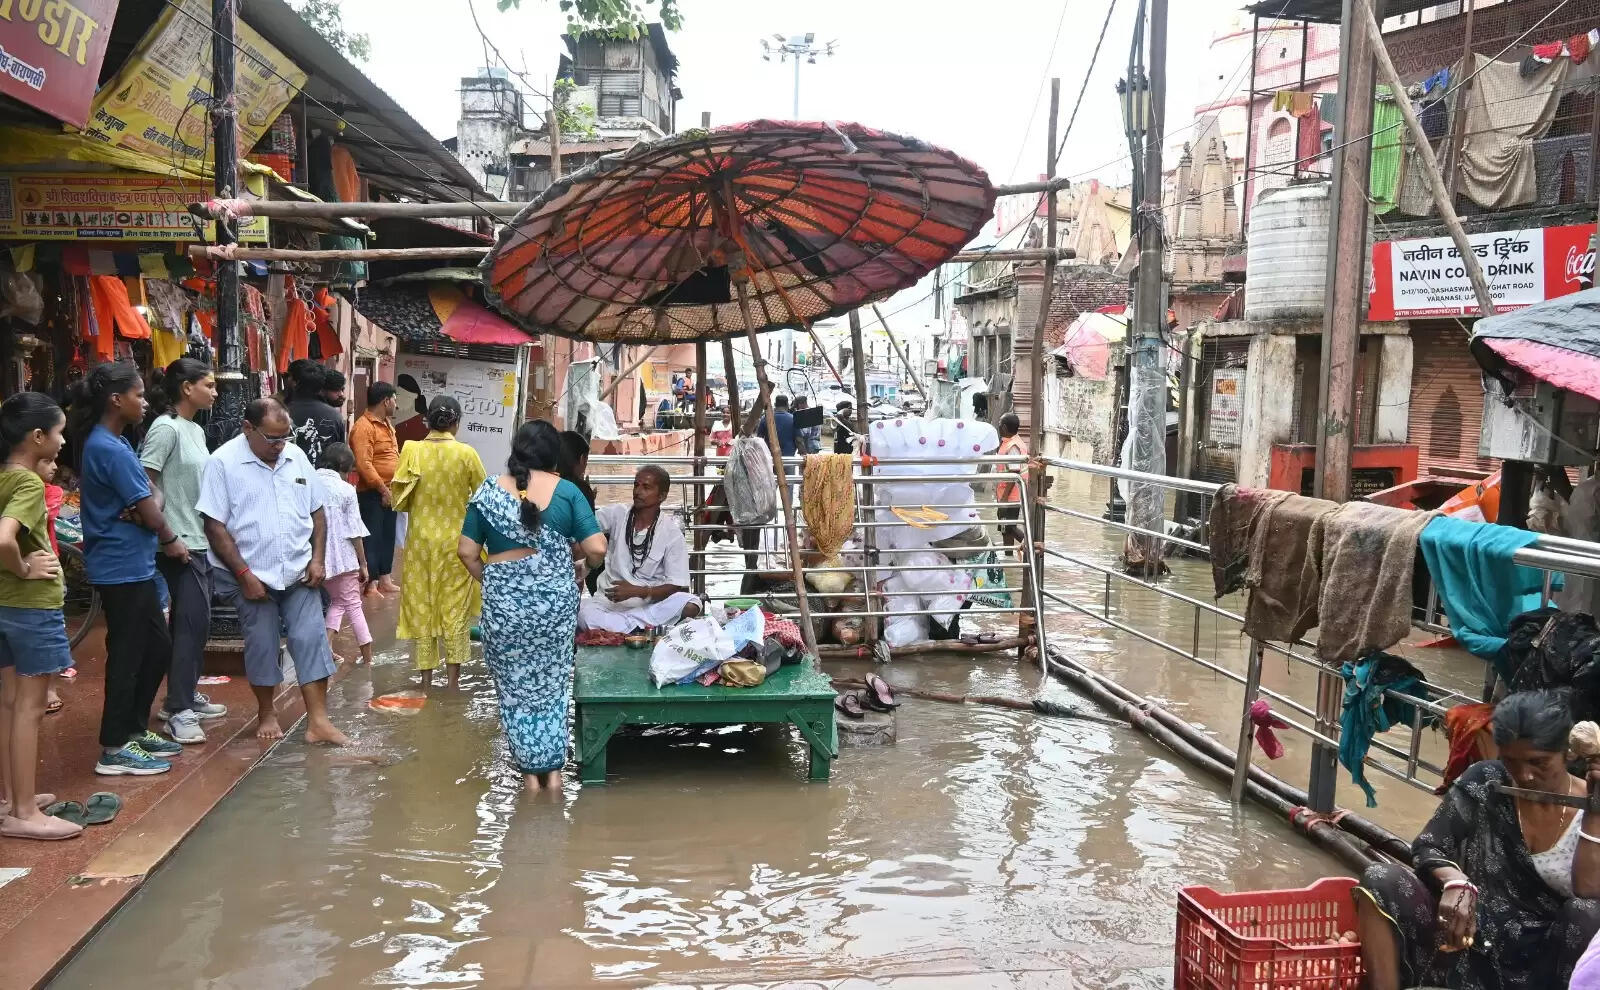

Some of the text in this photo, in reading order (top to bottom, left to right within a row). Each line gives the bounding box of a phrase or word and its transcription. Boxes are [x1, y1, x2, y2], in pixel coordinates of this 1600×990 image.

[0, 0, 98, 65] ण्डार
[1403, 245, 1444, 261] नवीन
[1493, 237, 1530, 260] ड्रिंक
[1400, 268, 1441, 282] NAVIN
[1488, 262, 1535, 276] DRINK
[1492, 283, 1511, 291] GHAT
